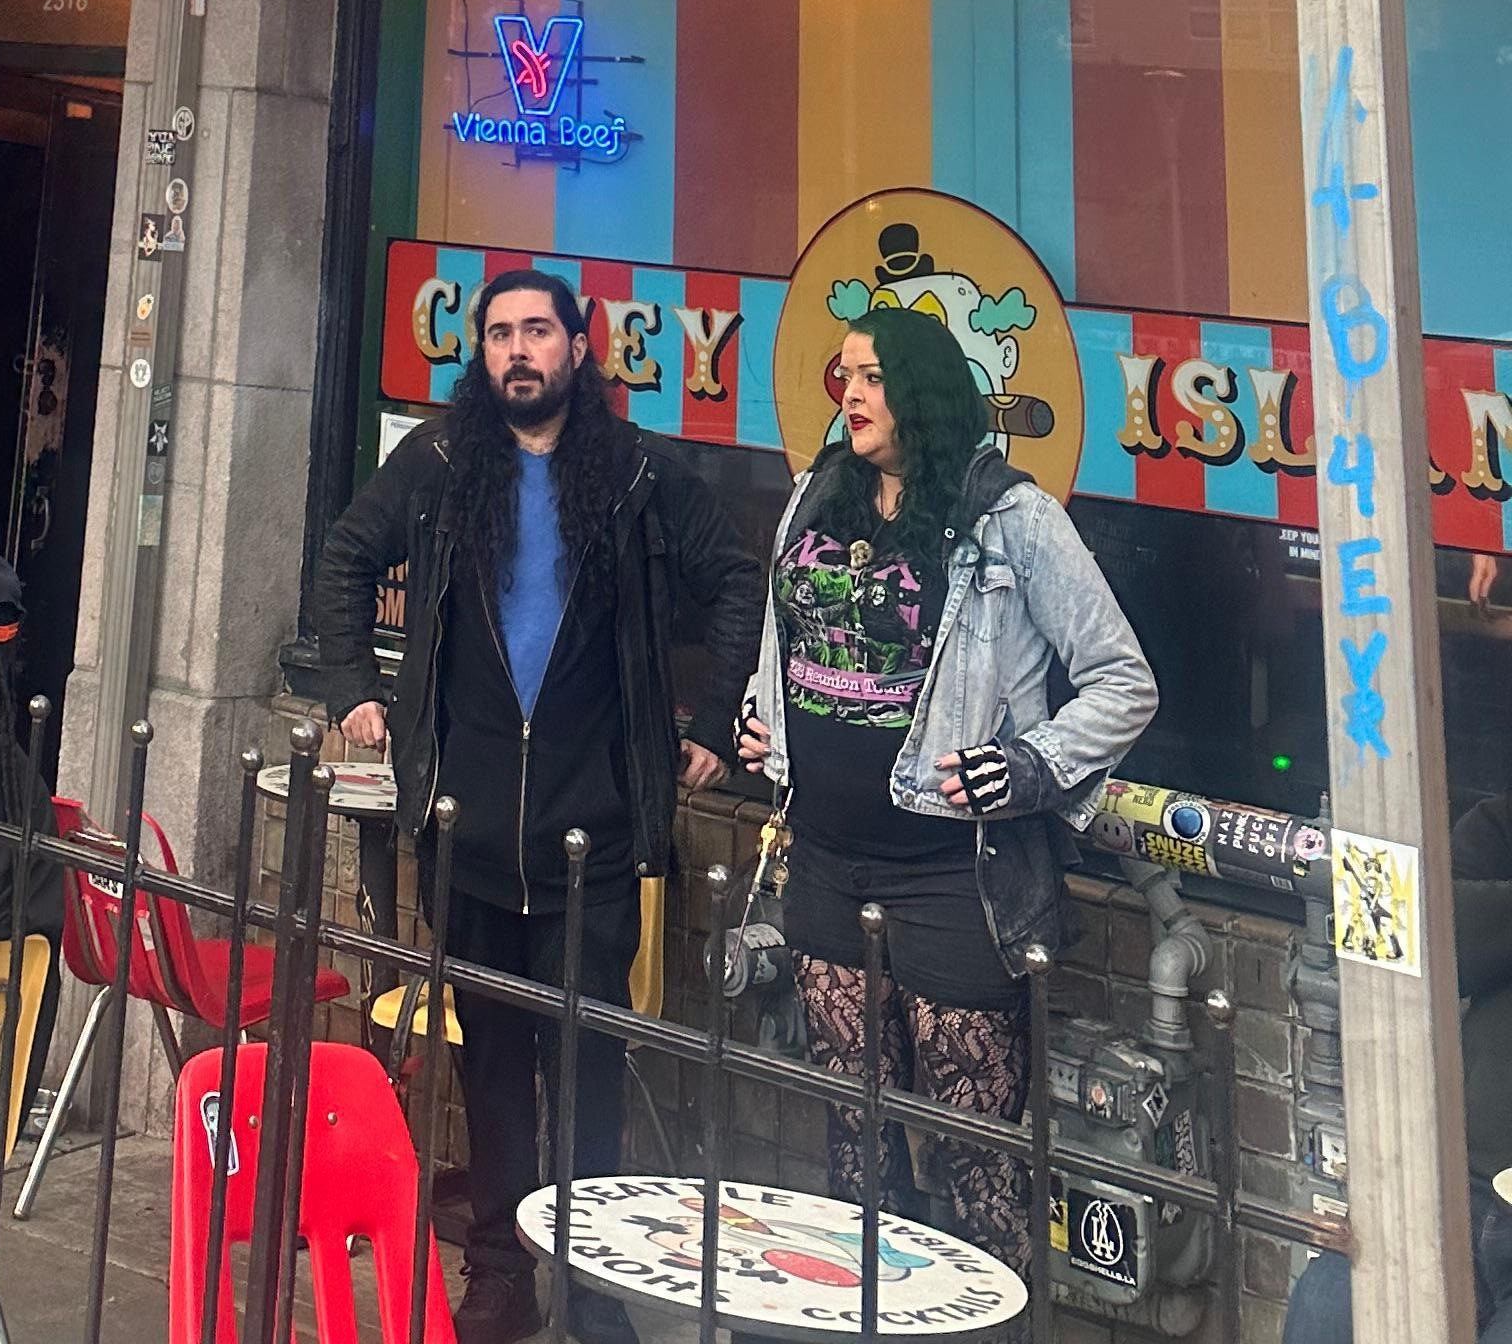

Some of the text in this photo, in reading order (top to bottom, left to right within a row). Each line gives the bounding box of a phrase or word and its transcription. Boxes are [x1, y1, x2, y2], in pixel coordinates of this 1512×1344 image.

[452, 112, 625, 154] Vienna Beef
[412, 278, 741, 400] CEY
[805, 668, 859, 693] Reunion
[1144, 832, 1206, 865] SNUZE
[1264, 823, 1278, 857] OFF
[801, 1286, 1005, 1326] COCKTAILS
